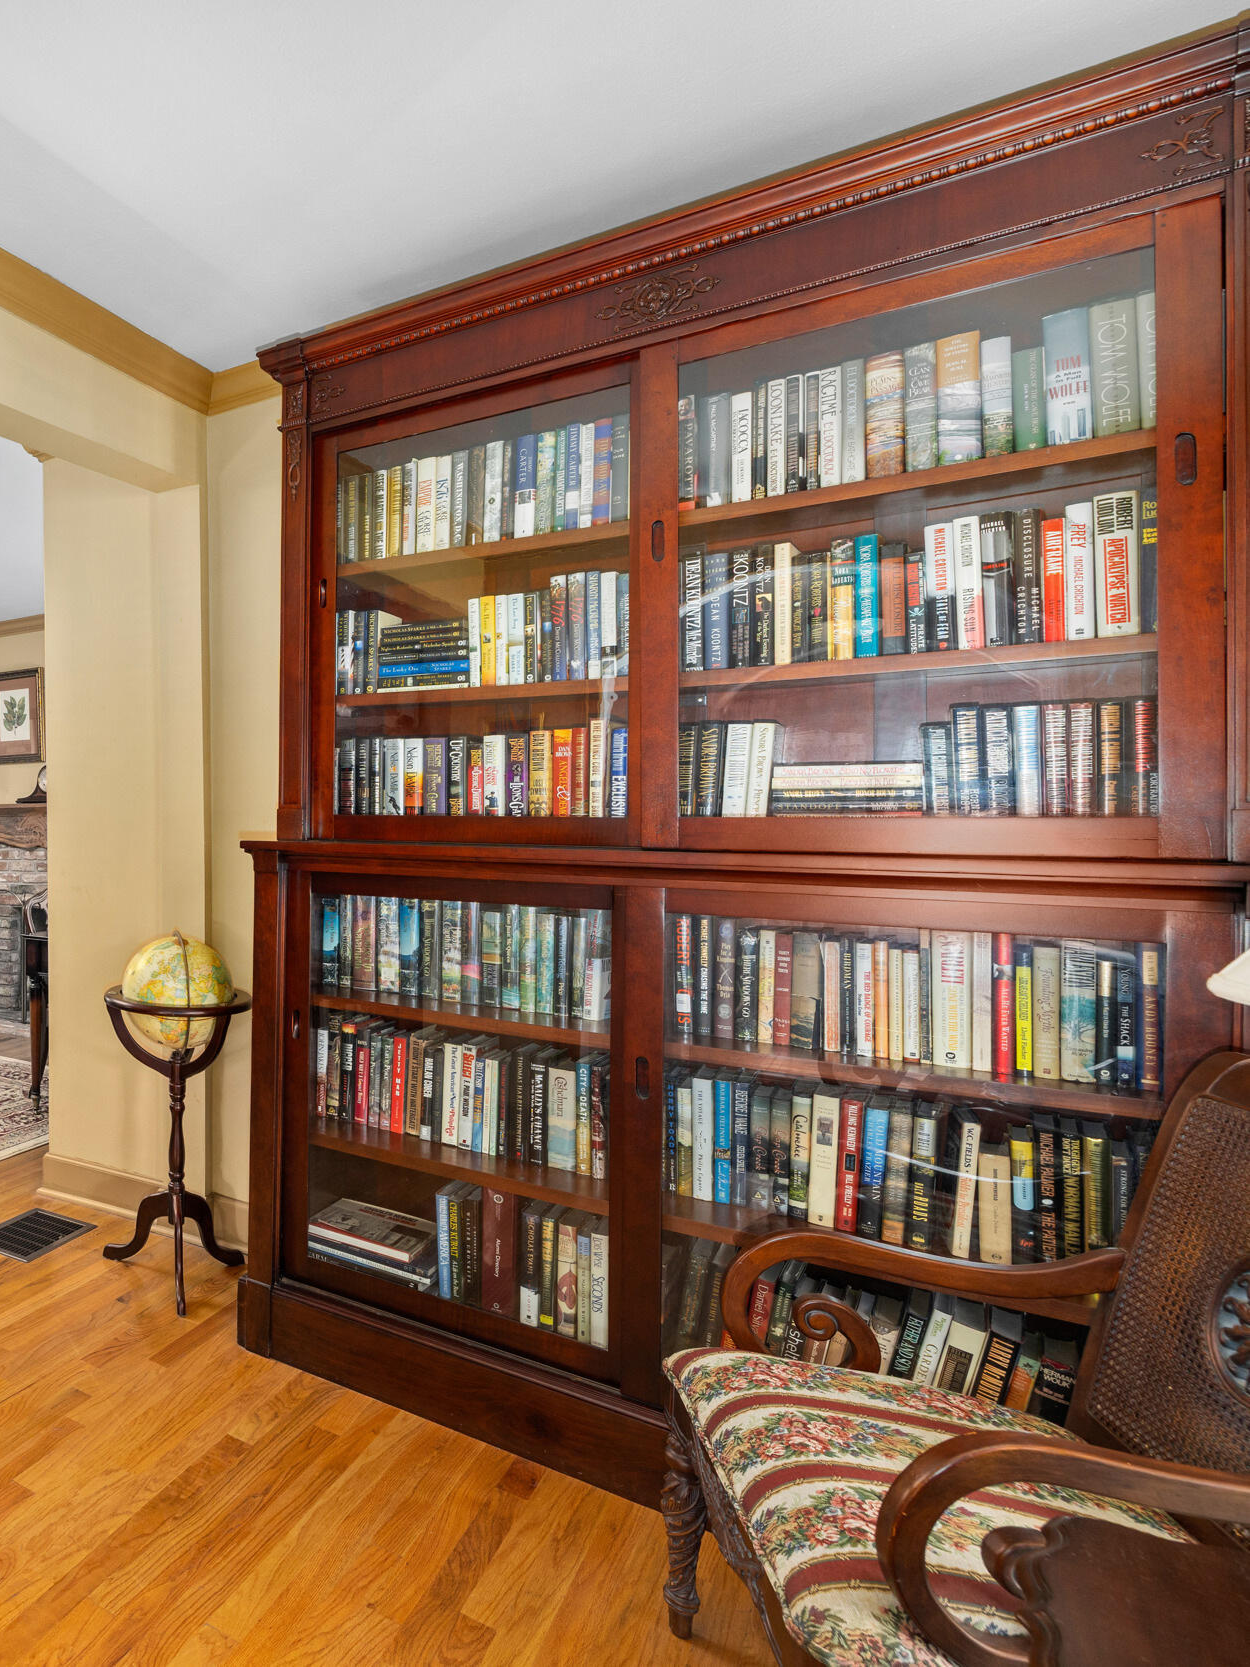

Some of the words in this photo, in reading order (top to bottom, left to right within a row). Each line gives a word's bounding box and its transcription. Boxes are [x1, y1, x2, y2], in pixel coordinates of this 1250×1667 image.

[1097, 314, 1128, 364] TOM
[908, 366, 931, 377] CLAN
[1053, 354, 1081, 372] TOM
[1049, 380, 1089, 400] WOLFE
[1100, 365, 1131, 427] WOLFE
[570, 427, 578, 452] JIMMY
[738, 408, 749, 454] IACOCCA
[770, 417, 783, 446] LAKE
[599, 439, 609, 460] TOM
[684, 422, 694, 499] PAVAROTTI
[519, 448, 527, 484] CARTER
[569, 454, 577, 486] CARTER
[375, 473, 385, 492] STEVE
[436, 478, 449, 500] 1876
[375, 494, 384, 522] MARTINI
[556, 490, 564, 516] CARTER
[1115, 497, 1134, 531] ROBERT
[1096, 498, 1115, 536] LUDLUM
[454, 525, 462, 543] D.C.
[934, 528, 948, 557] MICHAEL
[960, 523, 973, 543] MICHAEL
[1070, 524, 1086, 549] PREY
[374, 544, 383, 558] LIST
[859, 544, 872, 562] NORA
[1023, 519, 1033, 579] DISCLOSURE
[1046, 530, 1063, 576] AIRFRAME
[686, 558, 702, 587] DEAN
[934, 559, 948, 591] CRICHTON
[1074, 555, 1084, 584] MICHAEL
[1107, 538, 1126, 591] APOCALYPSE
[589, 574, 599, 599] SHARYN
[733, 558, 749, 608] KOONTZ
[551, 600, 565, 627] 1776
[569, 597, 584, 624] 1776
[686, 588, 702, 629] KOONTZ
[710, 597, 720, 621] DEAN
[892, 583, 903, 633] DISCLOSURE
[936, 595, 949, 614] STATE
[963, 588, 975, 614] RISING
[1017, 586, 1026, 634] CRICHTON
[1031, 587, 1040, 631] MICHAEL
[1074, 585, 1084, 615] CRICHTON
[1109, 593, 1127, 625] WATCH
[761, 619, 770, 638] Darkest
[910, 619, 918, 655] LATITUDES
[917, 624, 925, 648] PIRATE
[936, 623, 949, 640] FEAR
[964, 617, 976, 633] SUN
[711, 628, 721, 662] KOONTZ
[592, 722, 602, 733] THE
[956, 711, 978, 744] PATRICIA
[986, 711, 1008, 742] PATRICIA
[1045, 710, 1067, 742] PATRICIA
[1071, 708, 1093, 741] PATRICIA
[449, 740, 463, 750] UP
[532, 734, 545, 747] DAN
[678, 731, 695, 762] SANDRA
[701, 728, 719, 761] SANDRA
[729, 726, 747, 757] SANDRA
[757, 727, 769, 754] SANDRA
[406, 746, 421, 770] Nelson
[449, 751, 461, 782] COUNTRY
[531, 748, 545, 772] BROWN
[613, 753, 627, 771] Brown
[756, 755, 767, 779] BROWN
[1046, 743, 1067, 781] CORNWELL
[1071, 742, 1093, 780] CORNWELL
[698, 761, 717, 796] BROWN
[427, 792, 438, 813] GAME
[676, 918, 690, 967] ROBERT
[700, 967, 708, 990] CHASING
[843, 952, 852, 990] BIRDMAN
[1120, 968, 1131, 995] YOUNG
[741, 975, 755, 1006] SHADOWS
[1038, 967, 1054, 1005] Founding
[742, 1007, 751, 1018] GO
[1001, 1009, 1009, 1025] EVER
[1037, 1005, 1055, 1034] Myths
[1121, 1005, 1130, 1018] THE
[1145, 996, 1156, 1022] ANDY
[1000, 1026, 1008, 1052] WANTED
[1120, 1018, 1130, 1046] SHACK
[1145, 1026, 1156, 1067] ROONEY
[411, 1066, 419, 1082] START
[424, 1058, 434, 1080] HARLAN
[462, 1053, 475, 1080] SELECT
[516, 1056, 524, 1083] THOMAS
[410, 1083, 418, 1098] WITH
[423, 1080, 432, 1098] COBEN
[534, 1073, 543, 1114] McNALLY'S
[735, 1089, 748, 1114] BEFORE
[409, 1098, 417, 1130] WATERGATE
[462, 1098, 470, 1117] WILSON
[848, 1104, 858, 1126] KILLING
[534, 1115, 543, 1151] CHANCE
[735, 1117, 748, 1135] WAKE
[793, 1114, 808, 1158] Cataloochee
[846, 1126, 857, 1151] KENNEDY
[875, 1118, 885, 1146] COLD
[965, 1127, 975, 1142] W.C.
[918, 1133, 932, 1152] O'DELL
[964, 1142, 973, 1168] FIELDS
[1040, 1132, 1054, 1165] MICHAEL
[1062, 1137, 1071, 1155] DON'T
[1071, 1139, 1080, 1159] TOUGH
[752, 1145, 767, 1171] Creek
[772, 1149, 787, 1174] Creek
[864, 1151, 872, 1182] FRAZIER
[1062, 1155, 1071, 1174] DANCE
[872, 1150, 884, 1201] MOUNTAIN
[1041, 1166, 1055, 1197] PALMER
[1120, 1169, 1128, 1194] STRONG
[913, 1195, 929, 1222] ROADS
[1064, 1175, 1080, 1218] NORMAN
[449, 1202, 458, 1231] CHARLES
[1042, 1212, 1055, 1227] THE
[542, 1221, 554, 1240] THE
[439, 1231, 449, 1265] AMERICA
[450, 1231, 458, 1258] KURALT
[542, 1240, 554, 1262] WEB
[591, 1274, 605, 1313] SECONDS
[754, 1284, 769, 1313] Daniel
[900, 1316, 924, 1343] FATHER
[896, 1342, 915, 1358] AND
[986, 1337, 1016, 1368] LARRY
[893, 1357, 912, 1374] SON
